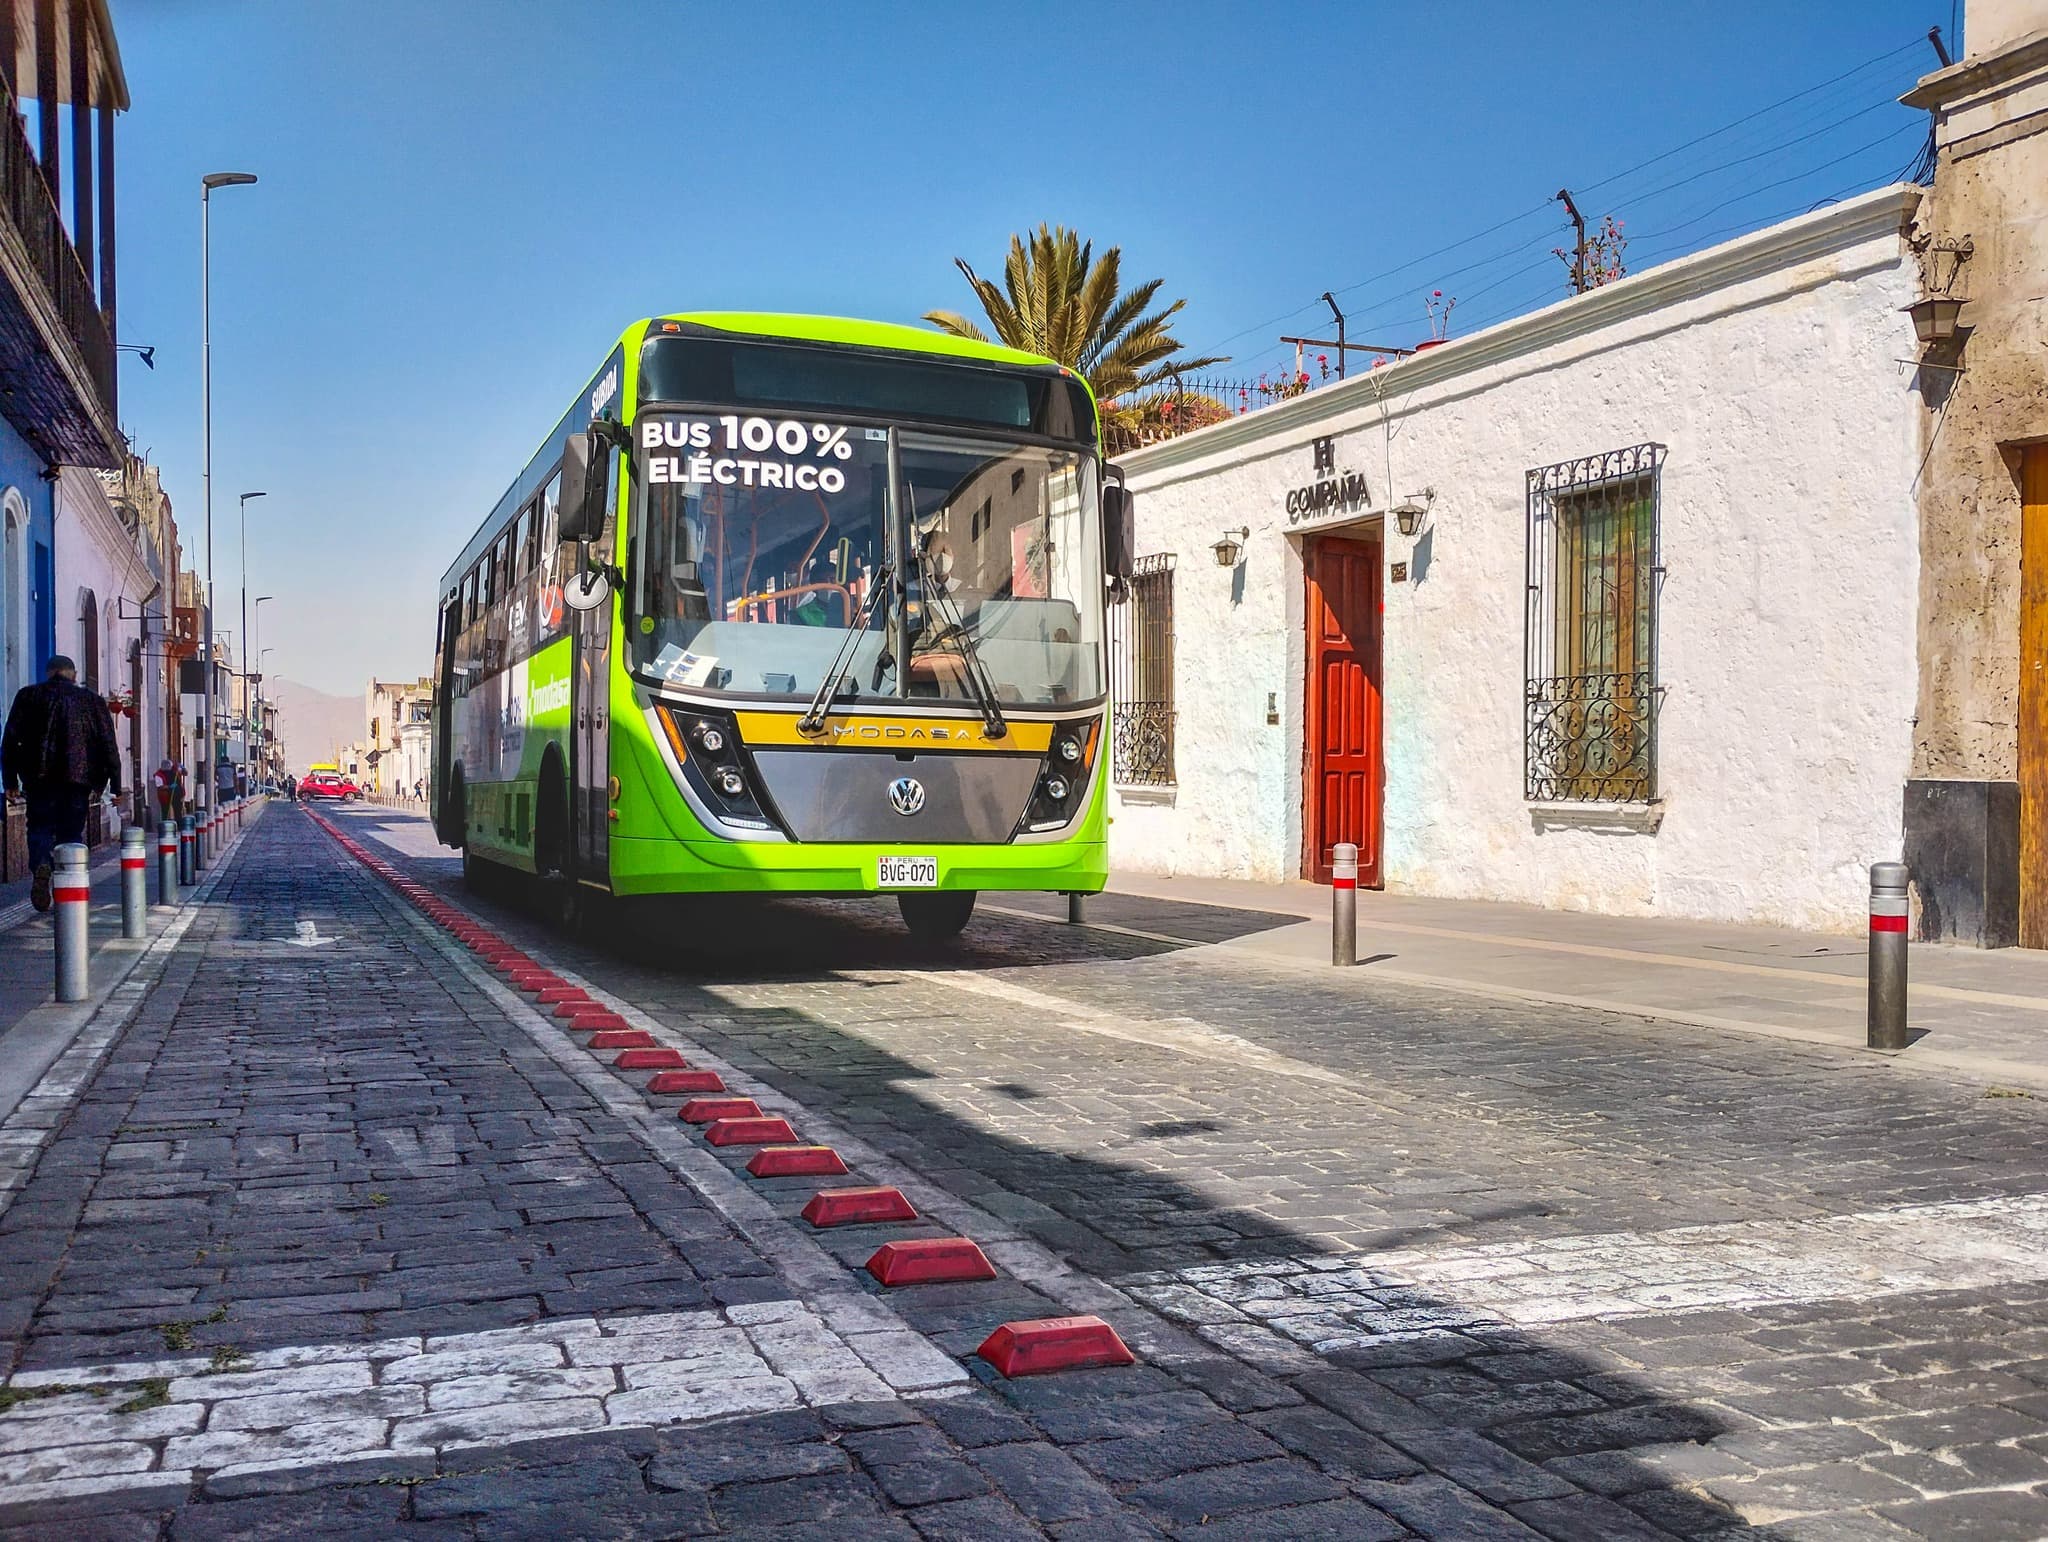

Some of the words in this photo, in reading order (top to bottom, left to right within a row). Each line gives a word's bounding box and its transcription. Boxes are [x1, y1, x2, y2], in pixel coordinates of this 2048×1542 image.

[591, 364, 617, 418] SUBIDA
[642, 422, 711, 448] BUS
[720, 415, 853, 460] 100%
[649, 451, 845, 493] ELÉCTRICO
[533, 673, 570, 716] modasa
[833, 725, 970, 740] MODASA
[881, 864, 935, 882] BVG-070
